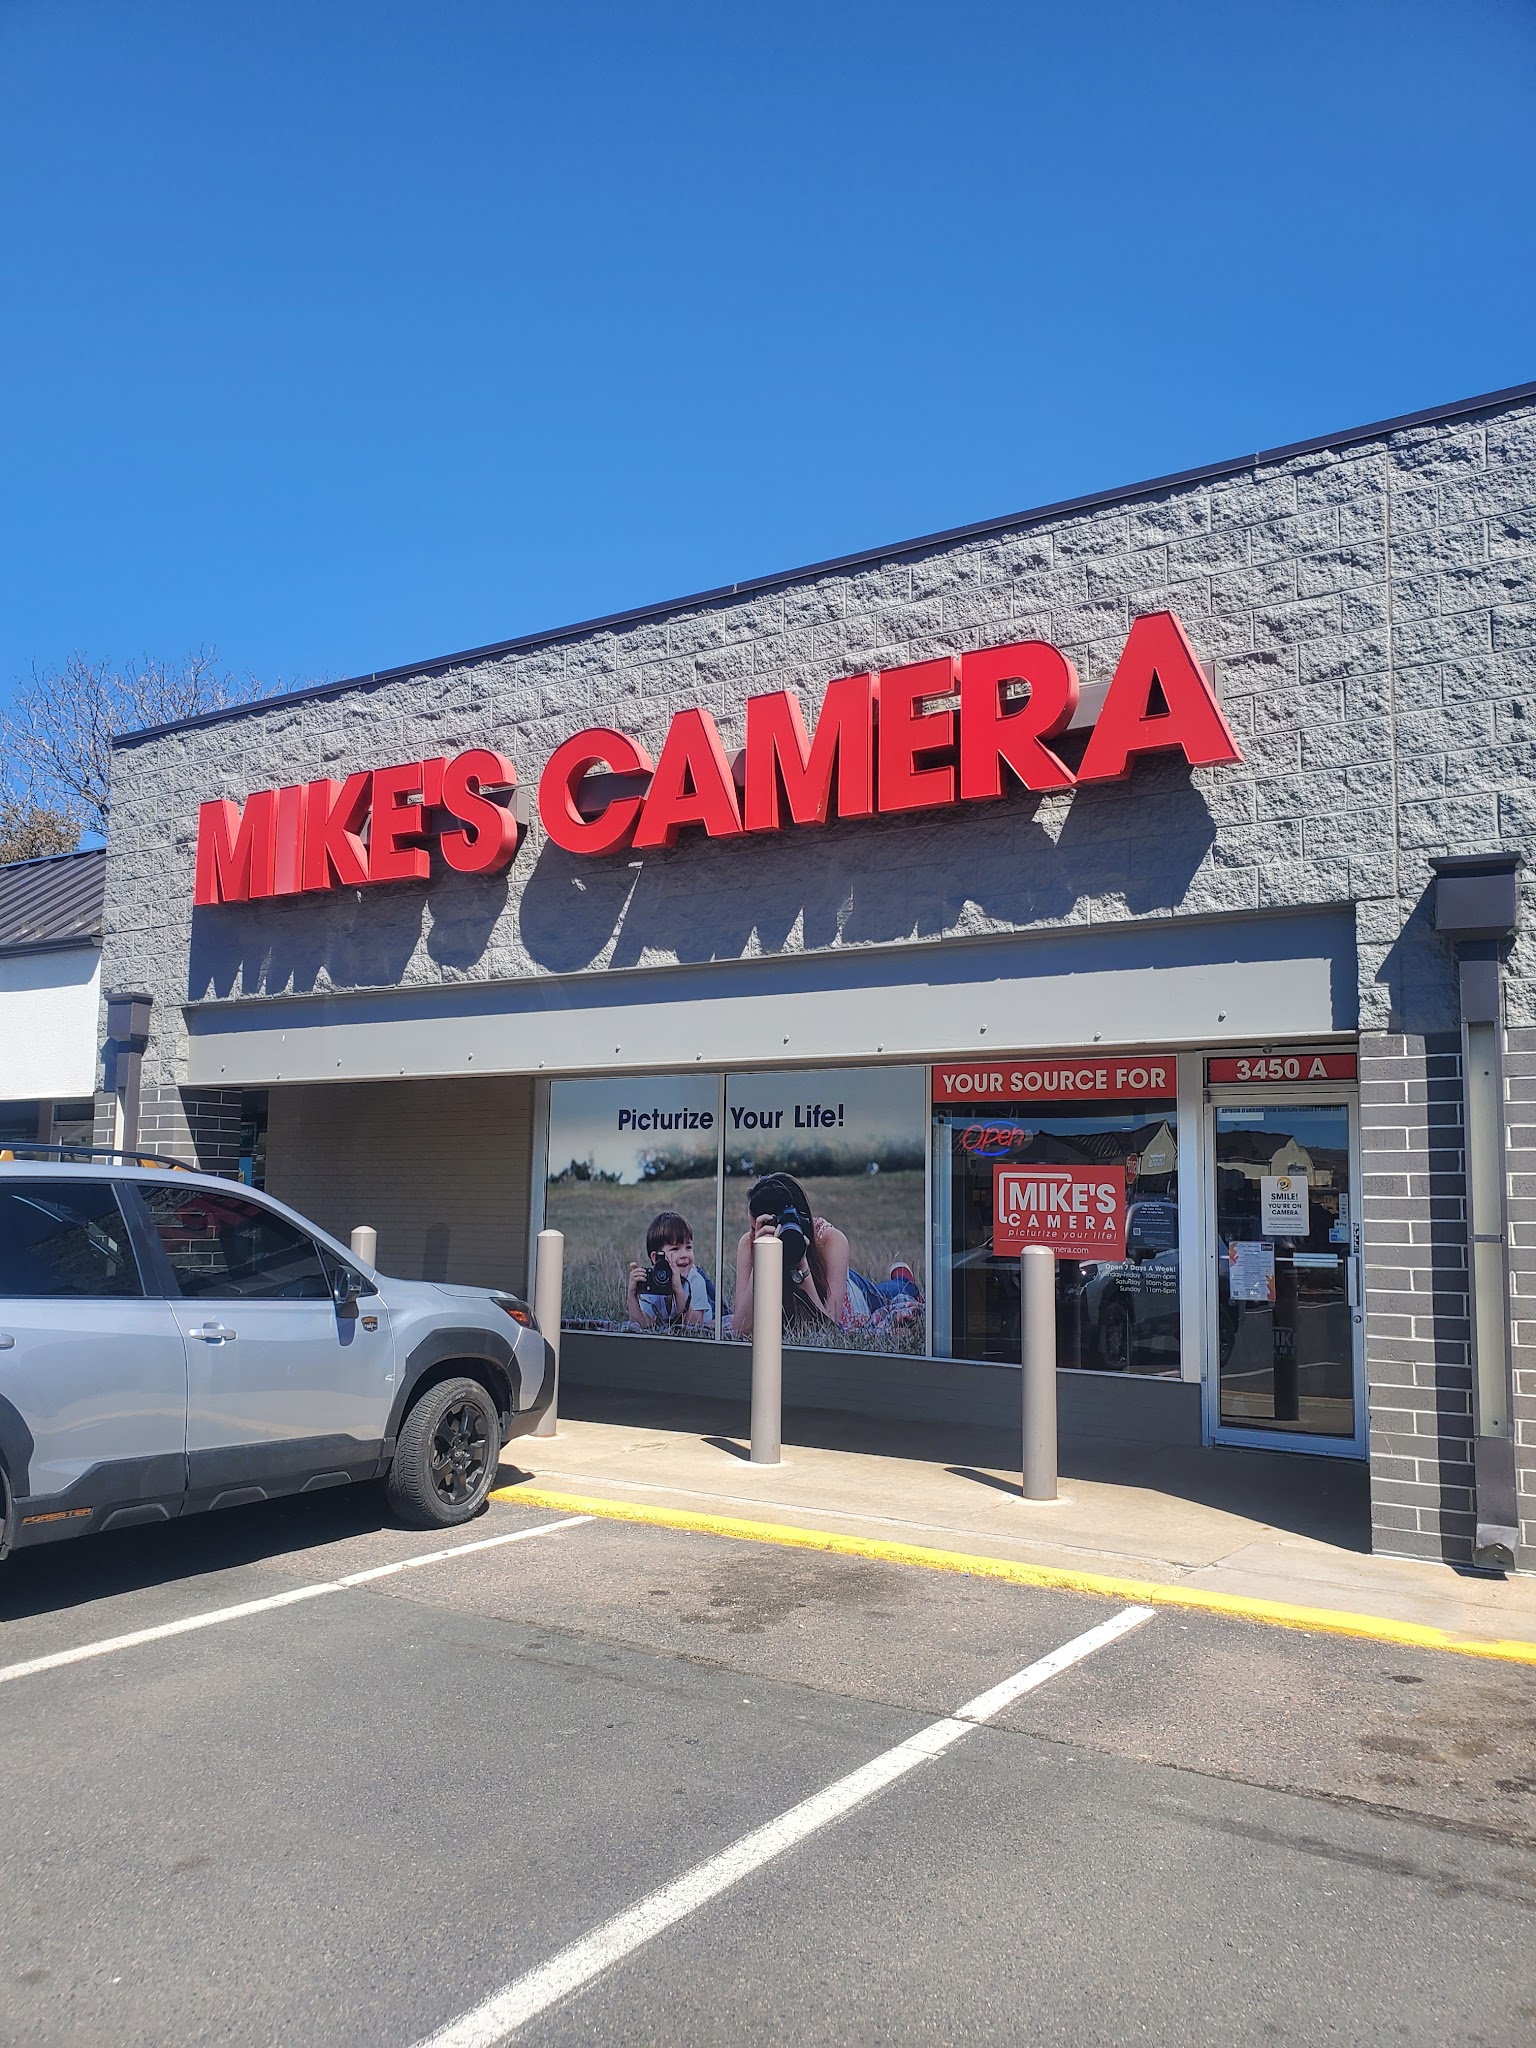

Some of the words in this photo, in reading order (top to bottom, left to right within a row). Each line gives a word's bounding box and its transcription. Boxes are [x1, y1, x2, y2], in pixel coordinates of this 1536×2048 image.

[195, 749, 517, 905] MIKE'S
[539, 609, 1244, 855] CAMERA
[1236, 1058, 1300, 1081] 3450
[1308, 1057, 1328, 1078] A
[943, 1073, 1004, 1093] YOUR
[1010, 1070, 1107, 1092] SOURCE
[1116, 1067, 1167, 1089] FOR
[618, 1107, 714, 1130] Picturize
[730, 1106, 783, 1129] Your
[794, 1103, 844, 1128] Life!
[962, 1124, 1025, 1151] Open
[1009, 1182, 1117, 1214] MIKE'S
[1008, 1213, 1116, 1231] CAMERA
[1008, 1228, 1057, 1238] picturize
[1062, 1231, 1088, 1241] your
[1093, 1231, 1117, 1240] life!
[1105, 1263, 1123, 1271] Open
[1130, 1265, 1147, 1273] Days
[1115, 1279, 1141, 1287] Saturday
[1119, 1286, 1141, 1294] Sunday
[22, 1507, 93, 1525] FORESTER
